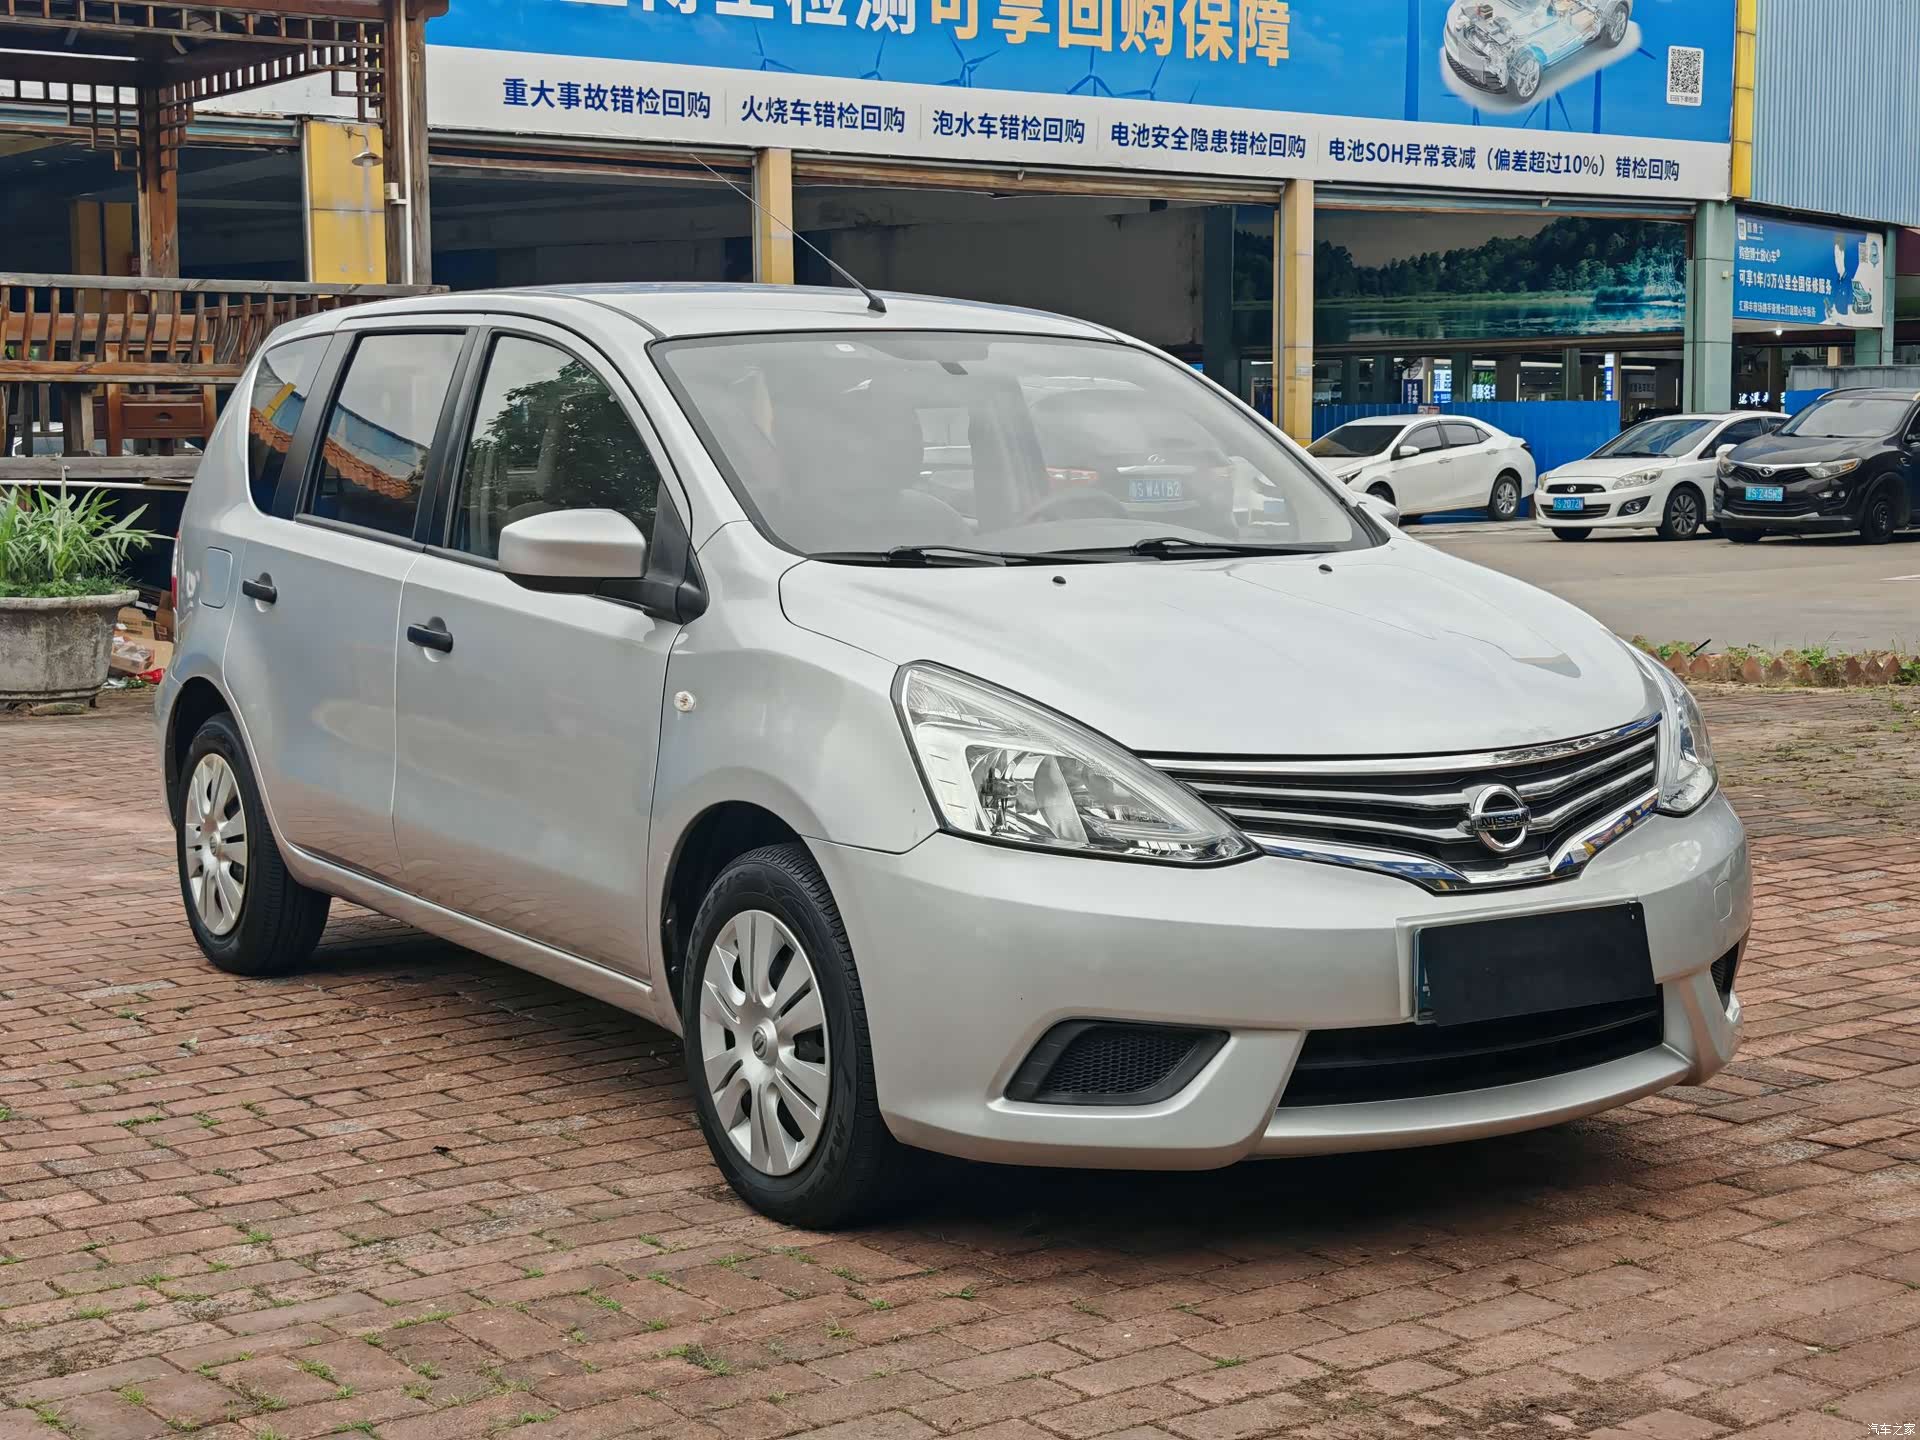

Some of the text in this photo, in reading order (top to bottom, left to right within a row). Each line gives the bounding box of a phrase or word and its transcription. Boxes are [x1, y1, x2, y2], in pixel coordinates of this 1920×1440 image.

[560, 0, 1290, 67] 可享回购保障
[502, 78, 711, 119] 重大事故错检回购
[740, 95, 906, 133] 火烧车错检回购
[932, 110, 1086, 145] 泡水车错检回购
[1111, 121, 1307, 159] 电池安全隐患错检回购
